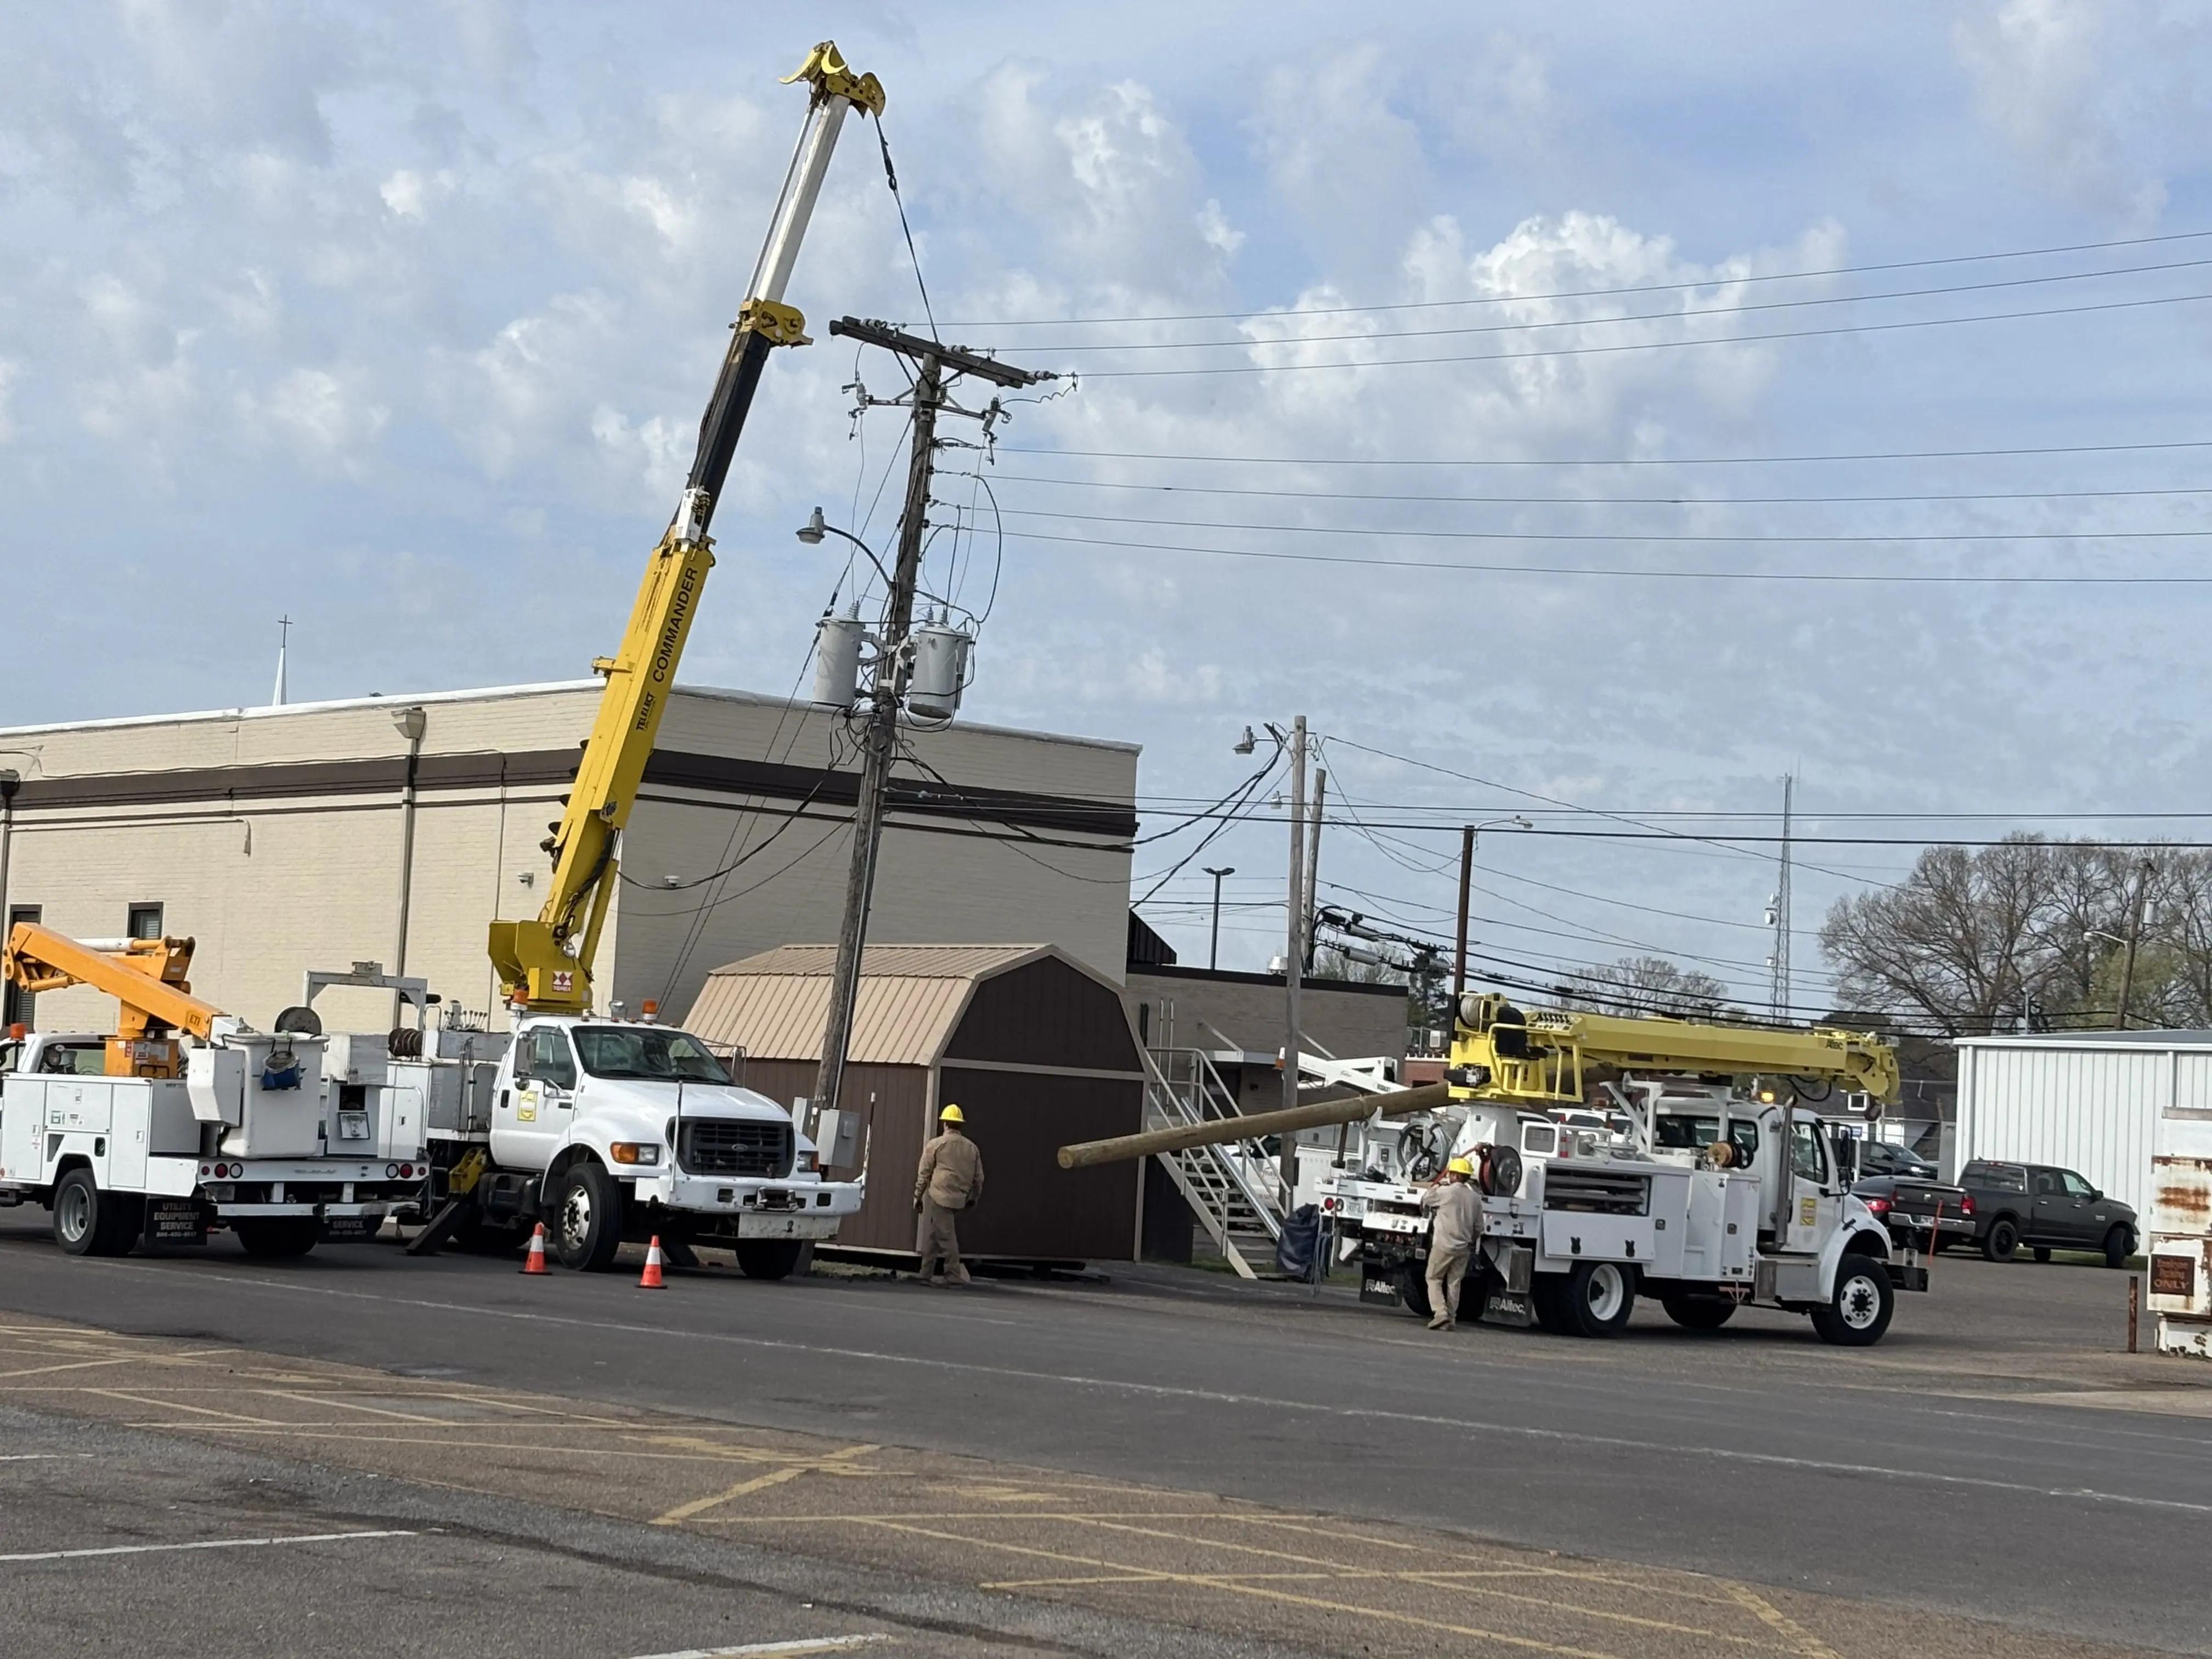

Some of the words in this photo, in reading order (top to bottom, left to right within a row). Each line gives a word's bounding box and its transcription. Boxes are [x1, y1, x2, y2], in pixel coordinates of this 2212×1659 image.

[652, 566, 698, 683] COMMANDER
[162, 1202, 192, 1211] UTILITY
[154, 1212, 200, 1221] EQUIPMENT
[160, 1221, 194, 1231] SERVICE
[2154, 1279, 2190, 1289] ONLY
